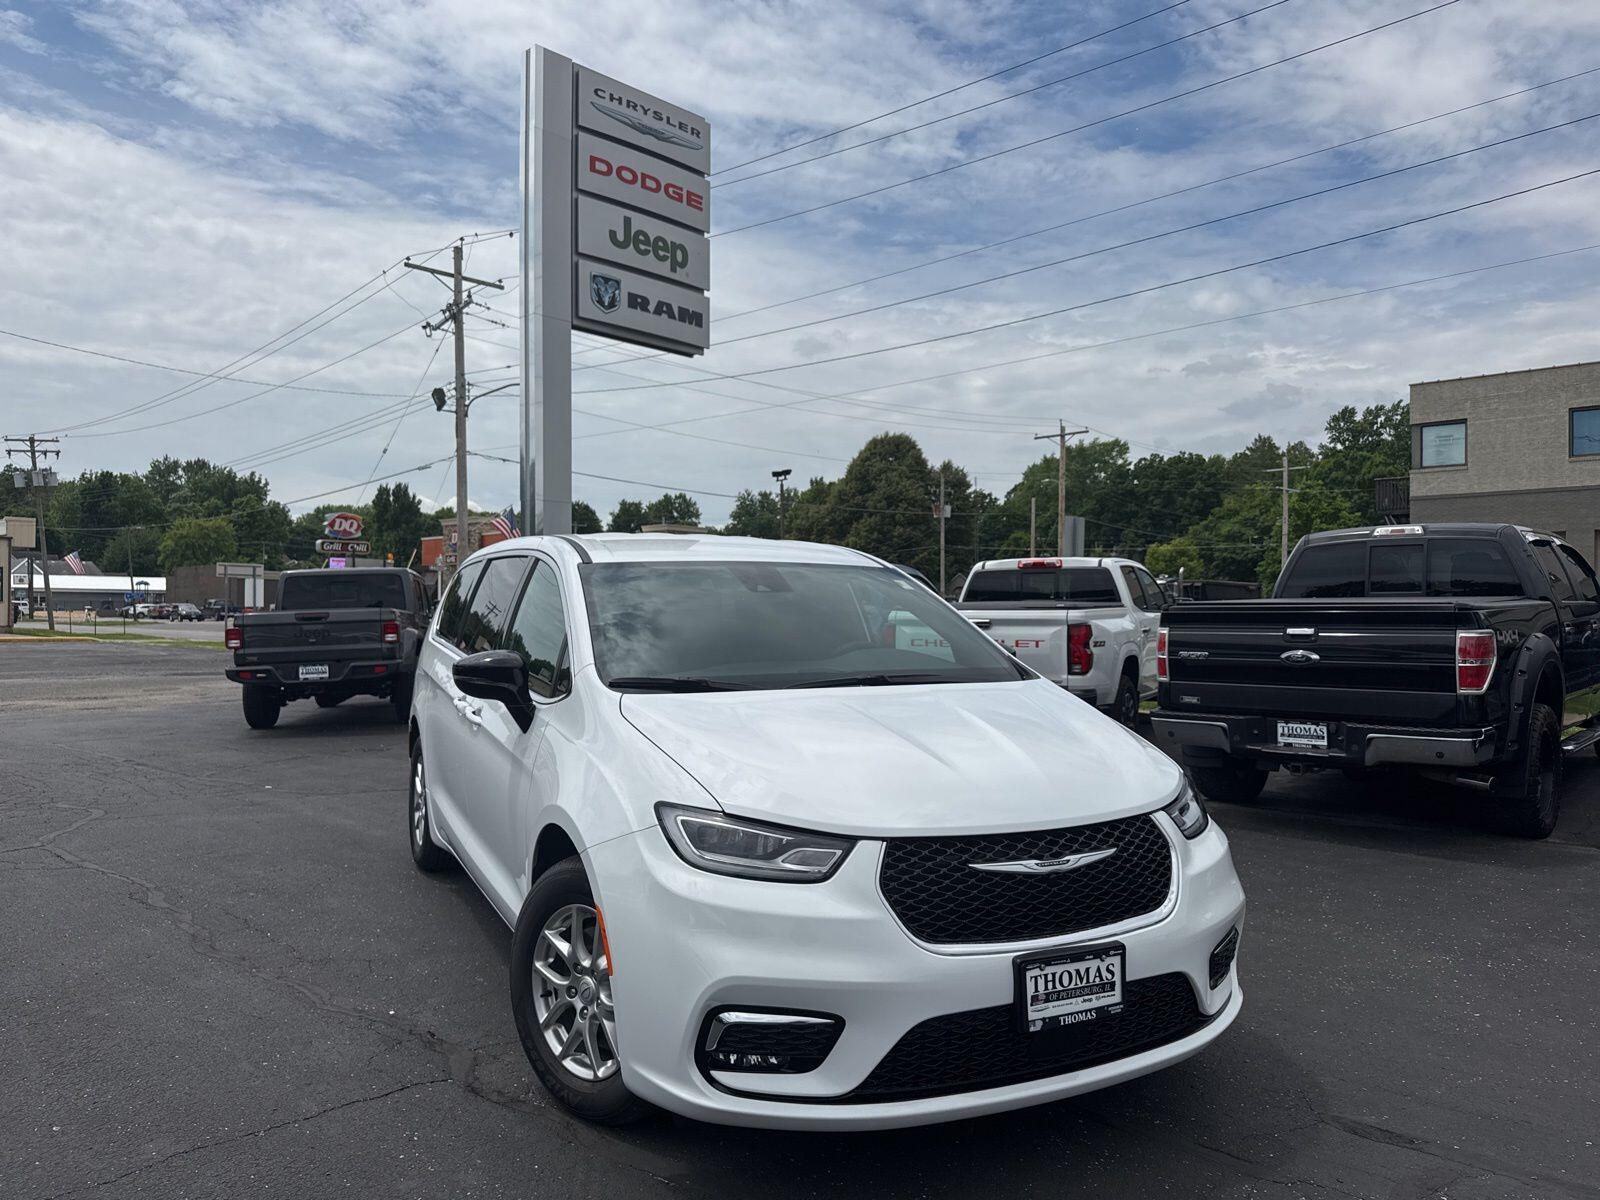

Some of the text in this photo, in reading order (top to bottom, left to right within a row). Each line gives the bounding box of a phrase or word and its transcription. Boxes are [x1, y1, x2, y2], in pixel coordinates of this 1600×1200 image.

[593, 87, 702, 139] CHRYSLER
[589, 154, 704, 212] DODGE
[608, 215, 689, 274] Jeep
[627, 291, 704, 328] RAM
[333, 518, 359, 534] DQ
[323, 542, 342, 551] Grill
[1279, 725, 1325, 735] THOMAS
[1030, 963, 1115, 994] THOMAS
[1049, 993, 1060, 1001] OF
[1059, 1009, 1097, 1025] THOMAS
